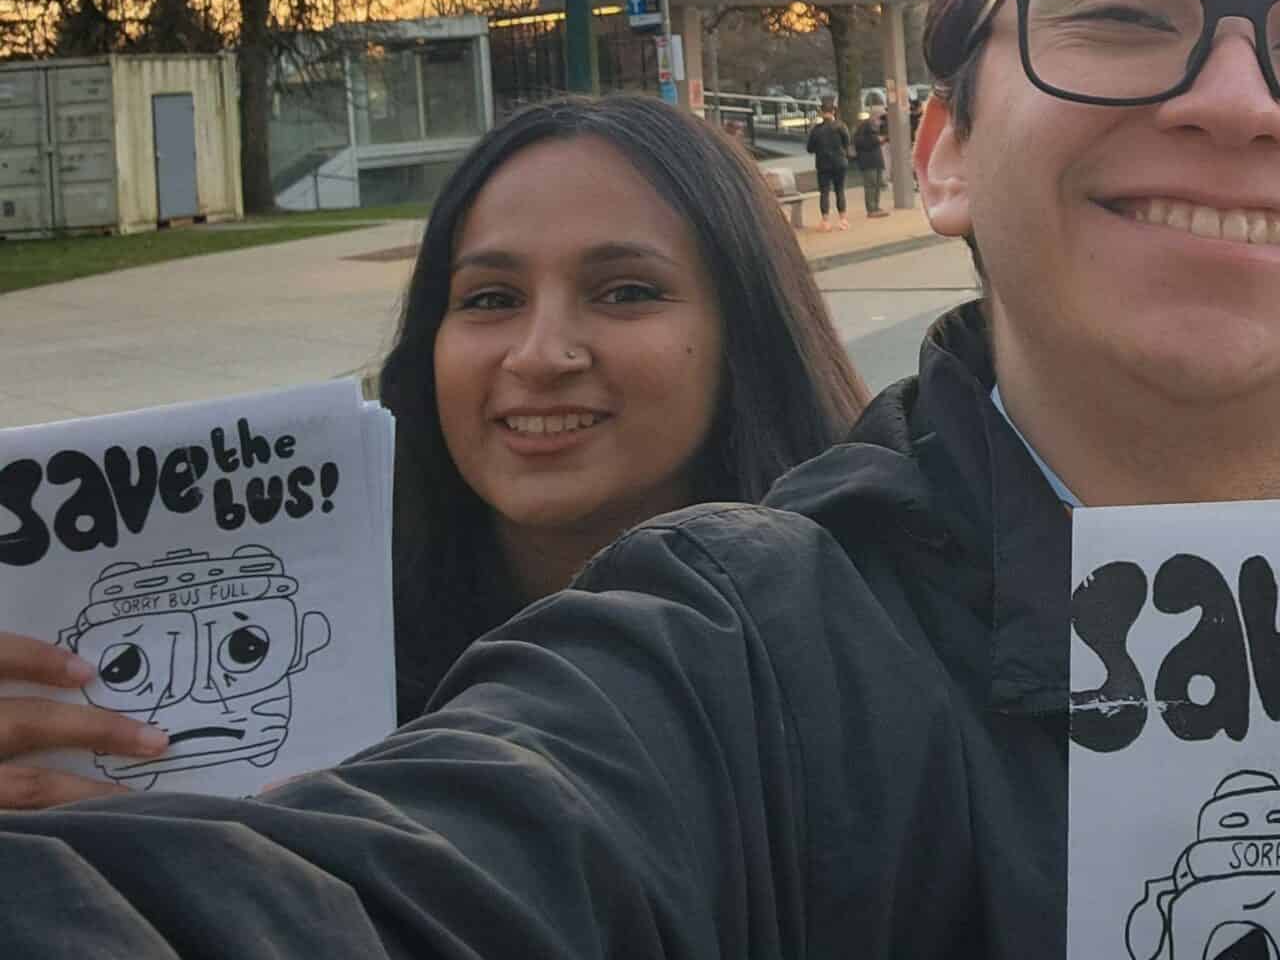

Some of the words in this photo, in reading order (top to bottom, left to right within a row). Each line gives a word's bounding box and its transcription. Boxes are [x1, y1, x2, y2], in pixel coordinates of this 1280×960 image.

[211, 417, 296, 473] the
[112, 595, 161, 617] SORRY
[169, 589, 201, 608] BUS
[210, 583, 249, 600] FULL
